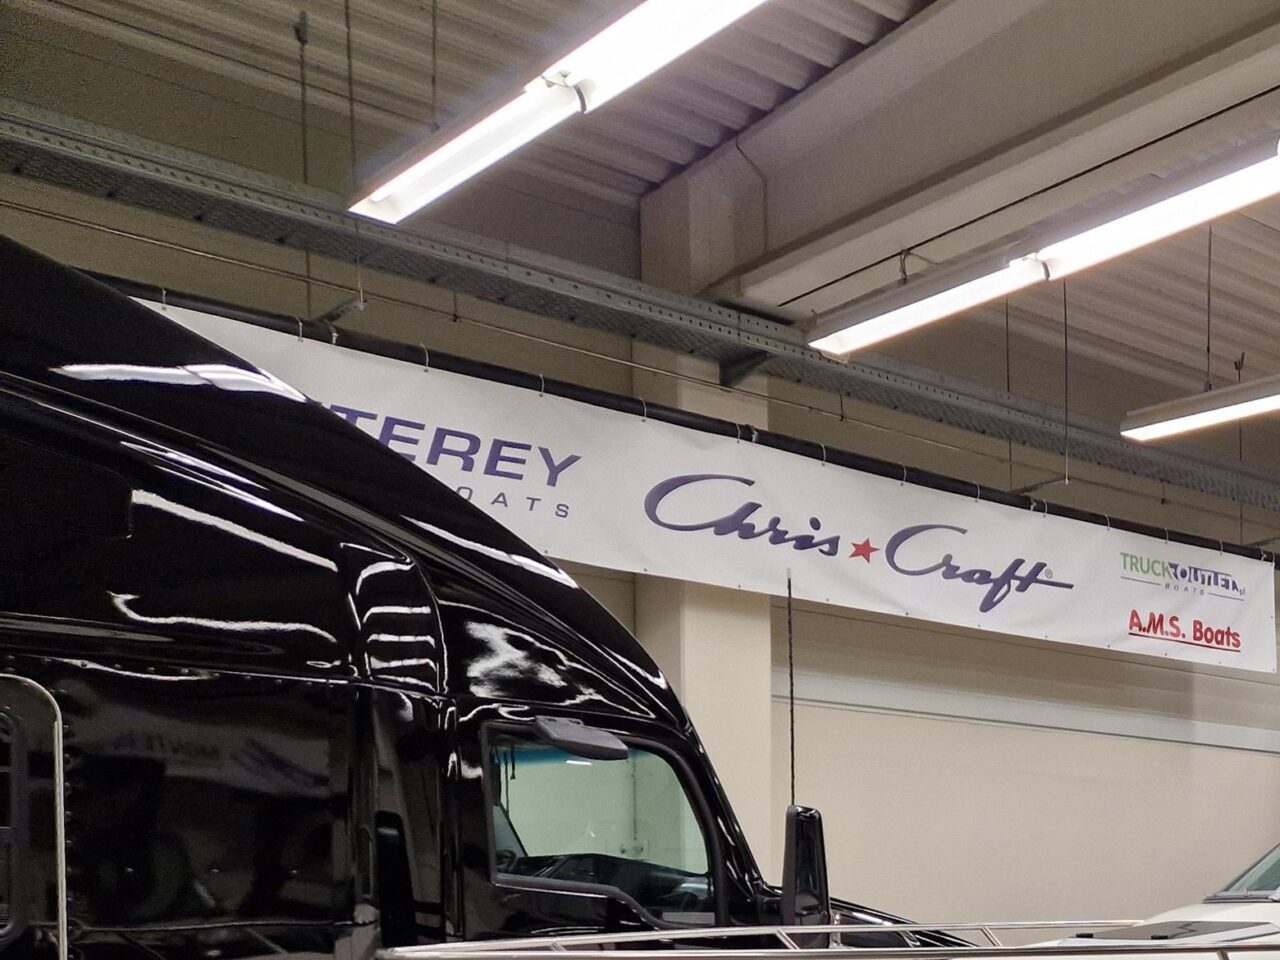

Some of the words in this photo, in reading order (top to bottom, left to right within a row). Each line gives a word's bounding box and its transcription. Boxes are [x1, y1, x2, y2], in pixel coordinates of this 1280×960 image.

[330, 404, 582, 488] TEREY
[456, 485, 570, 518] OATS
[644, 474, 841, 556] Chris
[1129, 609, 1186, 638] A.M.S.
[1193, 620, 1241, 648] Boats
